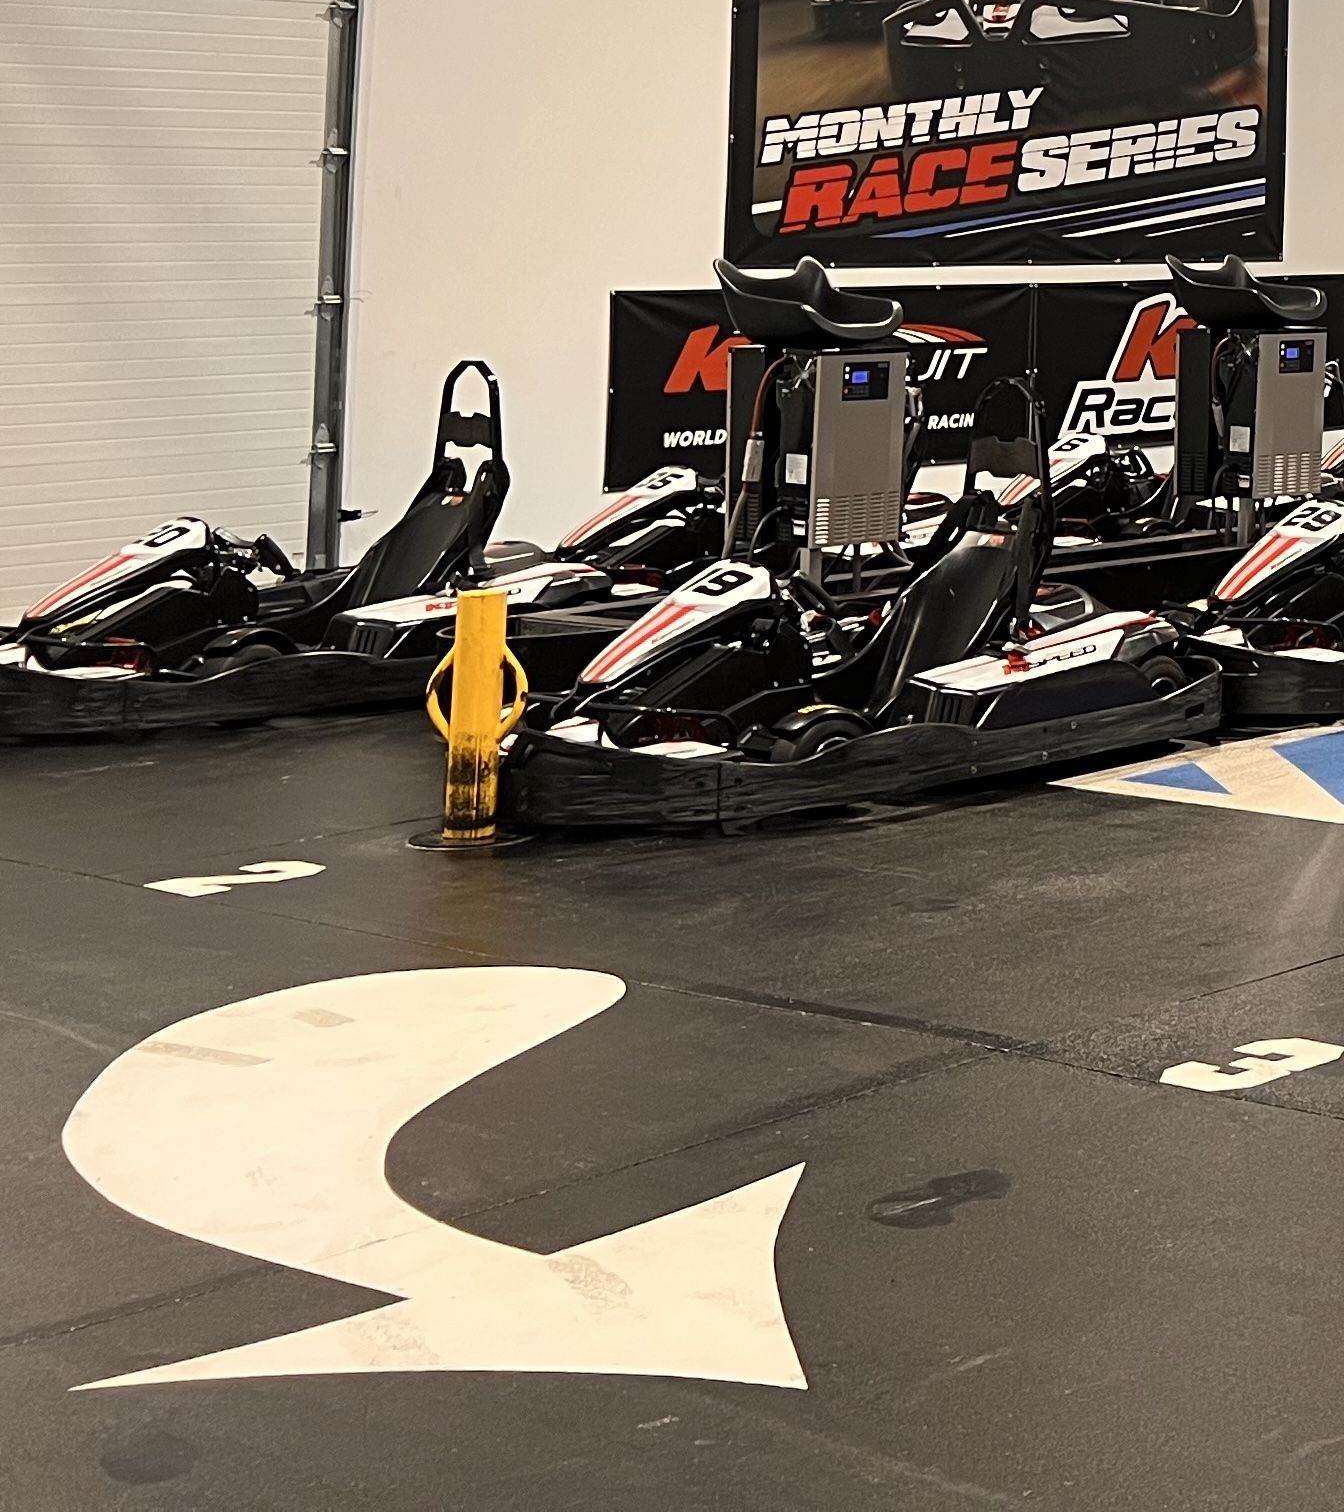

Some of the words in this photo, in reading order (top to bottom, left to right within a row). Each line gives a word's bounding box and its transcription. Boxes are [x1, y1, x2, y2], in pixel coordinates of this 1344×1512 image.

[757, 87, 1045, 165] MONTHLY
[779, 138, 1019, 235] RACE
[1018, 109, 1260, 192] SERIES
[928, 412, 975, 430] RACIN
[663, 429, 728, 448] WORLD
[1052, 437, 1090, 452] 6
[1282, 506, 1342, 531] 29
[680, 567, 754, 597] 19
[143, 861, 326, 897] 2
